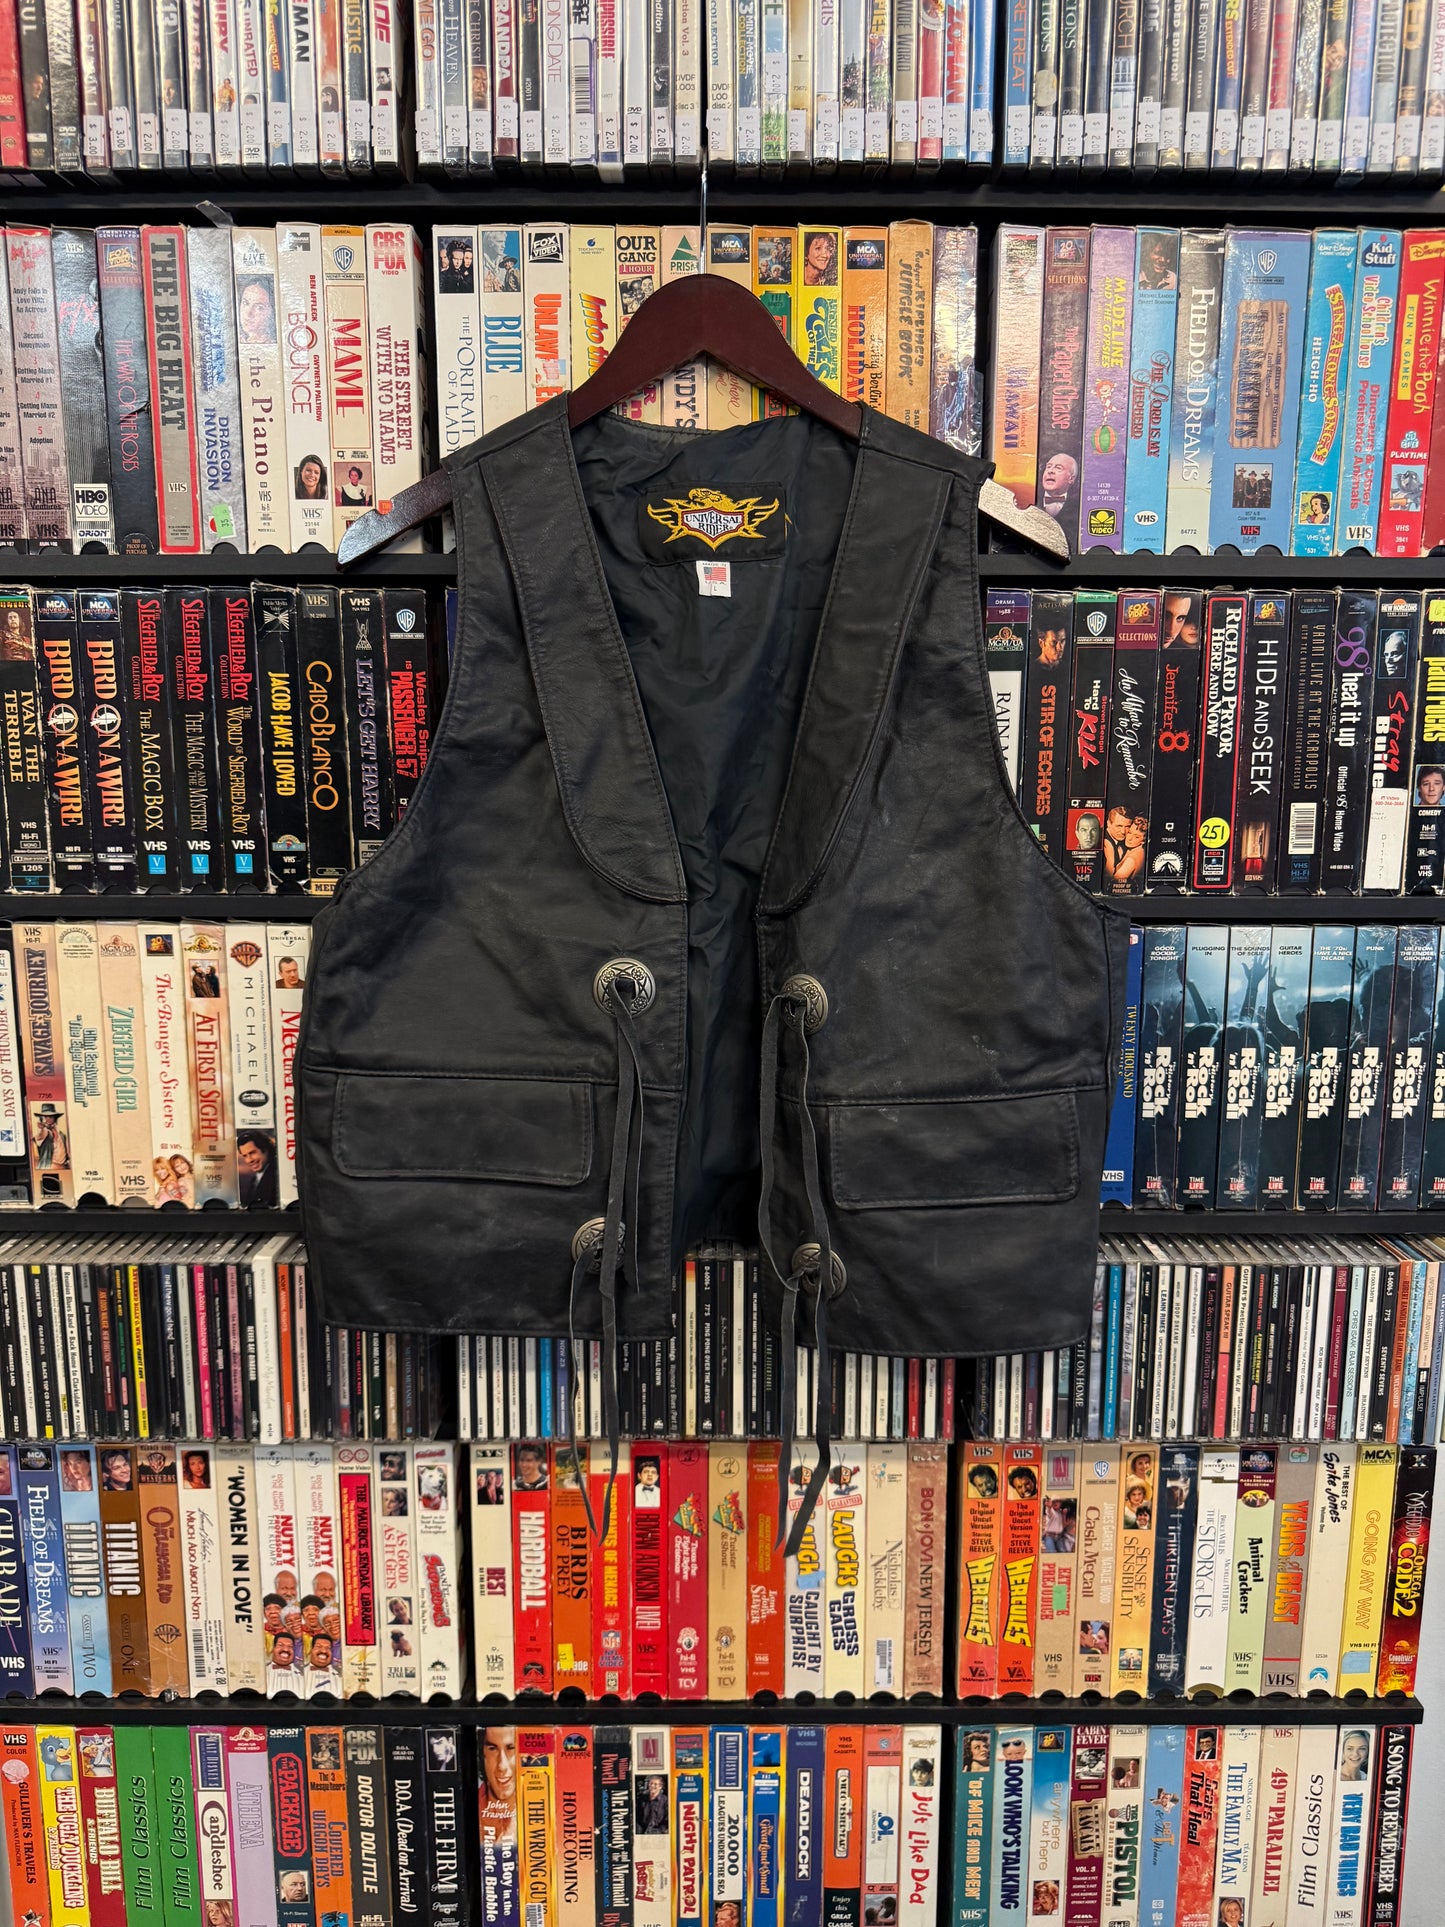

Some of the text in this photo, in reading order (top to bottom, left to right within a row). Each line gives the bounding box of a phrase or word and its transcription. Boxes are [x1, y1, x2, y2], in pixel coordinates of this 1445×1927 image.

[445, 15, 459, 85] HEAVEN
[88, 136, 98, 155] 3.00
[629, 135, 638, 155] 2.00
[373, 231, 405, 250] CBS
[374, 252, 407, 270] FOX
[533, 234, 558, 256] FOX VIDEO
[617, 236, 657, 251] OUR
[618, 252, 656, 262] GANG
[622, 265, 653, 273] 1 HOUR
[1364, 252, 1396, 265] Stuff
[1371, 243, 1393, 254] Kid
[151, 238, 186, 431] THE BIG HEAT
[484, 315, 522, 373] BLUE
[1110, 277, 1127, 369] MADELINE
[1413, 278, 1440, 415] Winnie the Pooh
[288, 312, 318, 414] BOUNCE
[313, 354, 321, 390] GWYNETH
[332, 319, 365, 418] MAME
[376, 325, 396, 466] WITH NO NAME
[394, 339, 413, 451] THE STREET
[1181, 286, 1216, 482] FIELD OF DREAMS
[1308, 337, 1322, 403] HEIGH-HO
[203, 407, 220, 492] INVASION
[218, 416, 232, 484] DRAGON
[250, 357, 274, 476] the Piano
[1390, 451, 1427, 459] PLAYTIME
[75, 490, 107, 505] HBO
[76, 505, 108, 515] VIDEO
[685, 510, 741, 524] UNIVERSAL
[698, 523, 729, 536] RIDER
[1136, 514, 1156, 523] VHS
[268, 671, 291, 712] JACOB
[1205, 628, 1225, 738] HERE AND NOW
[1216, 607, 1242, 759] RICHARD PRYOR,
[1249, 640, 1279, 796] HIDE AND SEEK
[1333, 672, 1364, 748] heat it up
[4, 690, 24, 783] TERRIBLE
[21, 690, 40, 783] IVAN THE
[270, 714, 293, 749] HAVE
[356, 658, 380, 831] LET'S GET HARRY
[391, 671, 419, 779] PASSENGER 57
[1035, 684, 1057, 816] STIR OF ECHOES
[139, 709, 165, 831] THE MAGIC BOX
[273, 758, 297, 797] LOVED
[144, 841, 167, 851] VHS
[1202, 824, 1225, 841] 251
[24, 948, 55, 1077] SAVAGE JOURNEY
[244, 977, 260, 1082] MICHAEL
[155, 974, 179, 1129] The Banger Sisters
[194, 1012, 220, 1141] AT FIRST SIGHT
[120, 1176, 146, 1185] VHS
[1323, 1452, 1341, 1524] Spike Jones
[1340, 1500, 1347, 1511] OF
[1343, 1465, 1351, 1479] THE
[64, 1521, 103, 1598] TITANIC
[105, 1521, 142, 1597] TITANIC
[232, 1554, 249, 1571] IN
[520, 1511, 546, 1612] HARDBALL
[556, 1524, 571, 1600] OF PREY
[570, 1526, 588, 1600] BIRDS
[832, 1511, 859, 1587] LAUGHS
[1082, 1506, 1101, 1598] Cash McCall
[1248, 1536, 1264, 1583] Animal
[1355, 1509, 1381, 1630] GOING MY WAY
[842, 1590, 859, 1657] GROSS
[1237, 1560, 1251, 1615] Crackers
[82, 1647, 97, 1678] TWO
[121, 1644, 136, 1676] ONE
[789, 1594, 807, 1669] SURPRISE
[828, 1599, 845, 1652] GAGS
[1267, 1674, 1295, 1686] VHS
[4, 1734, 27, 1744] VHS
[128, 1776, 153, 1910] Film Classics
[201, 1800, 227, 1891] Candleshoe
[357, 1775, 378, 1894] DOCTOR DOLITTLE
[433, 1787, 458, 1891] THE FIRM
[563, 1791, 579, 1903] HOMECOMING
[726, 1814, 740, 1876] 20,000
[798, 1771, 809, 1878] DEADLOCK
[1000, 1760, 1024, 1910] LOOK WHO'S TALKING
[1221, 1762, 1248, 1886] THE FAMILY MAN
[1297, 1774, 1324, 1908] Film Classics
[1111, 1821, 1140, 1907] PISTOL
